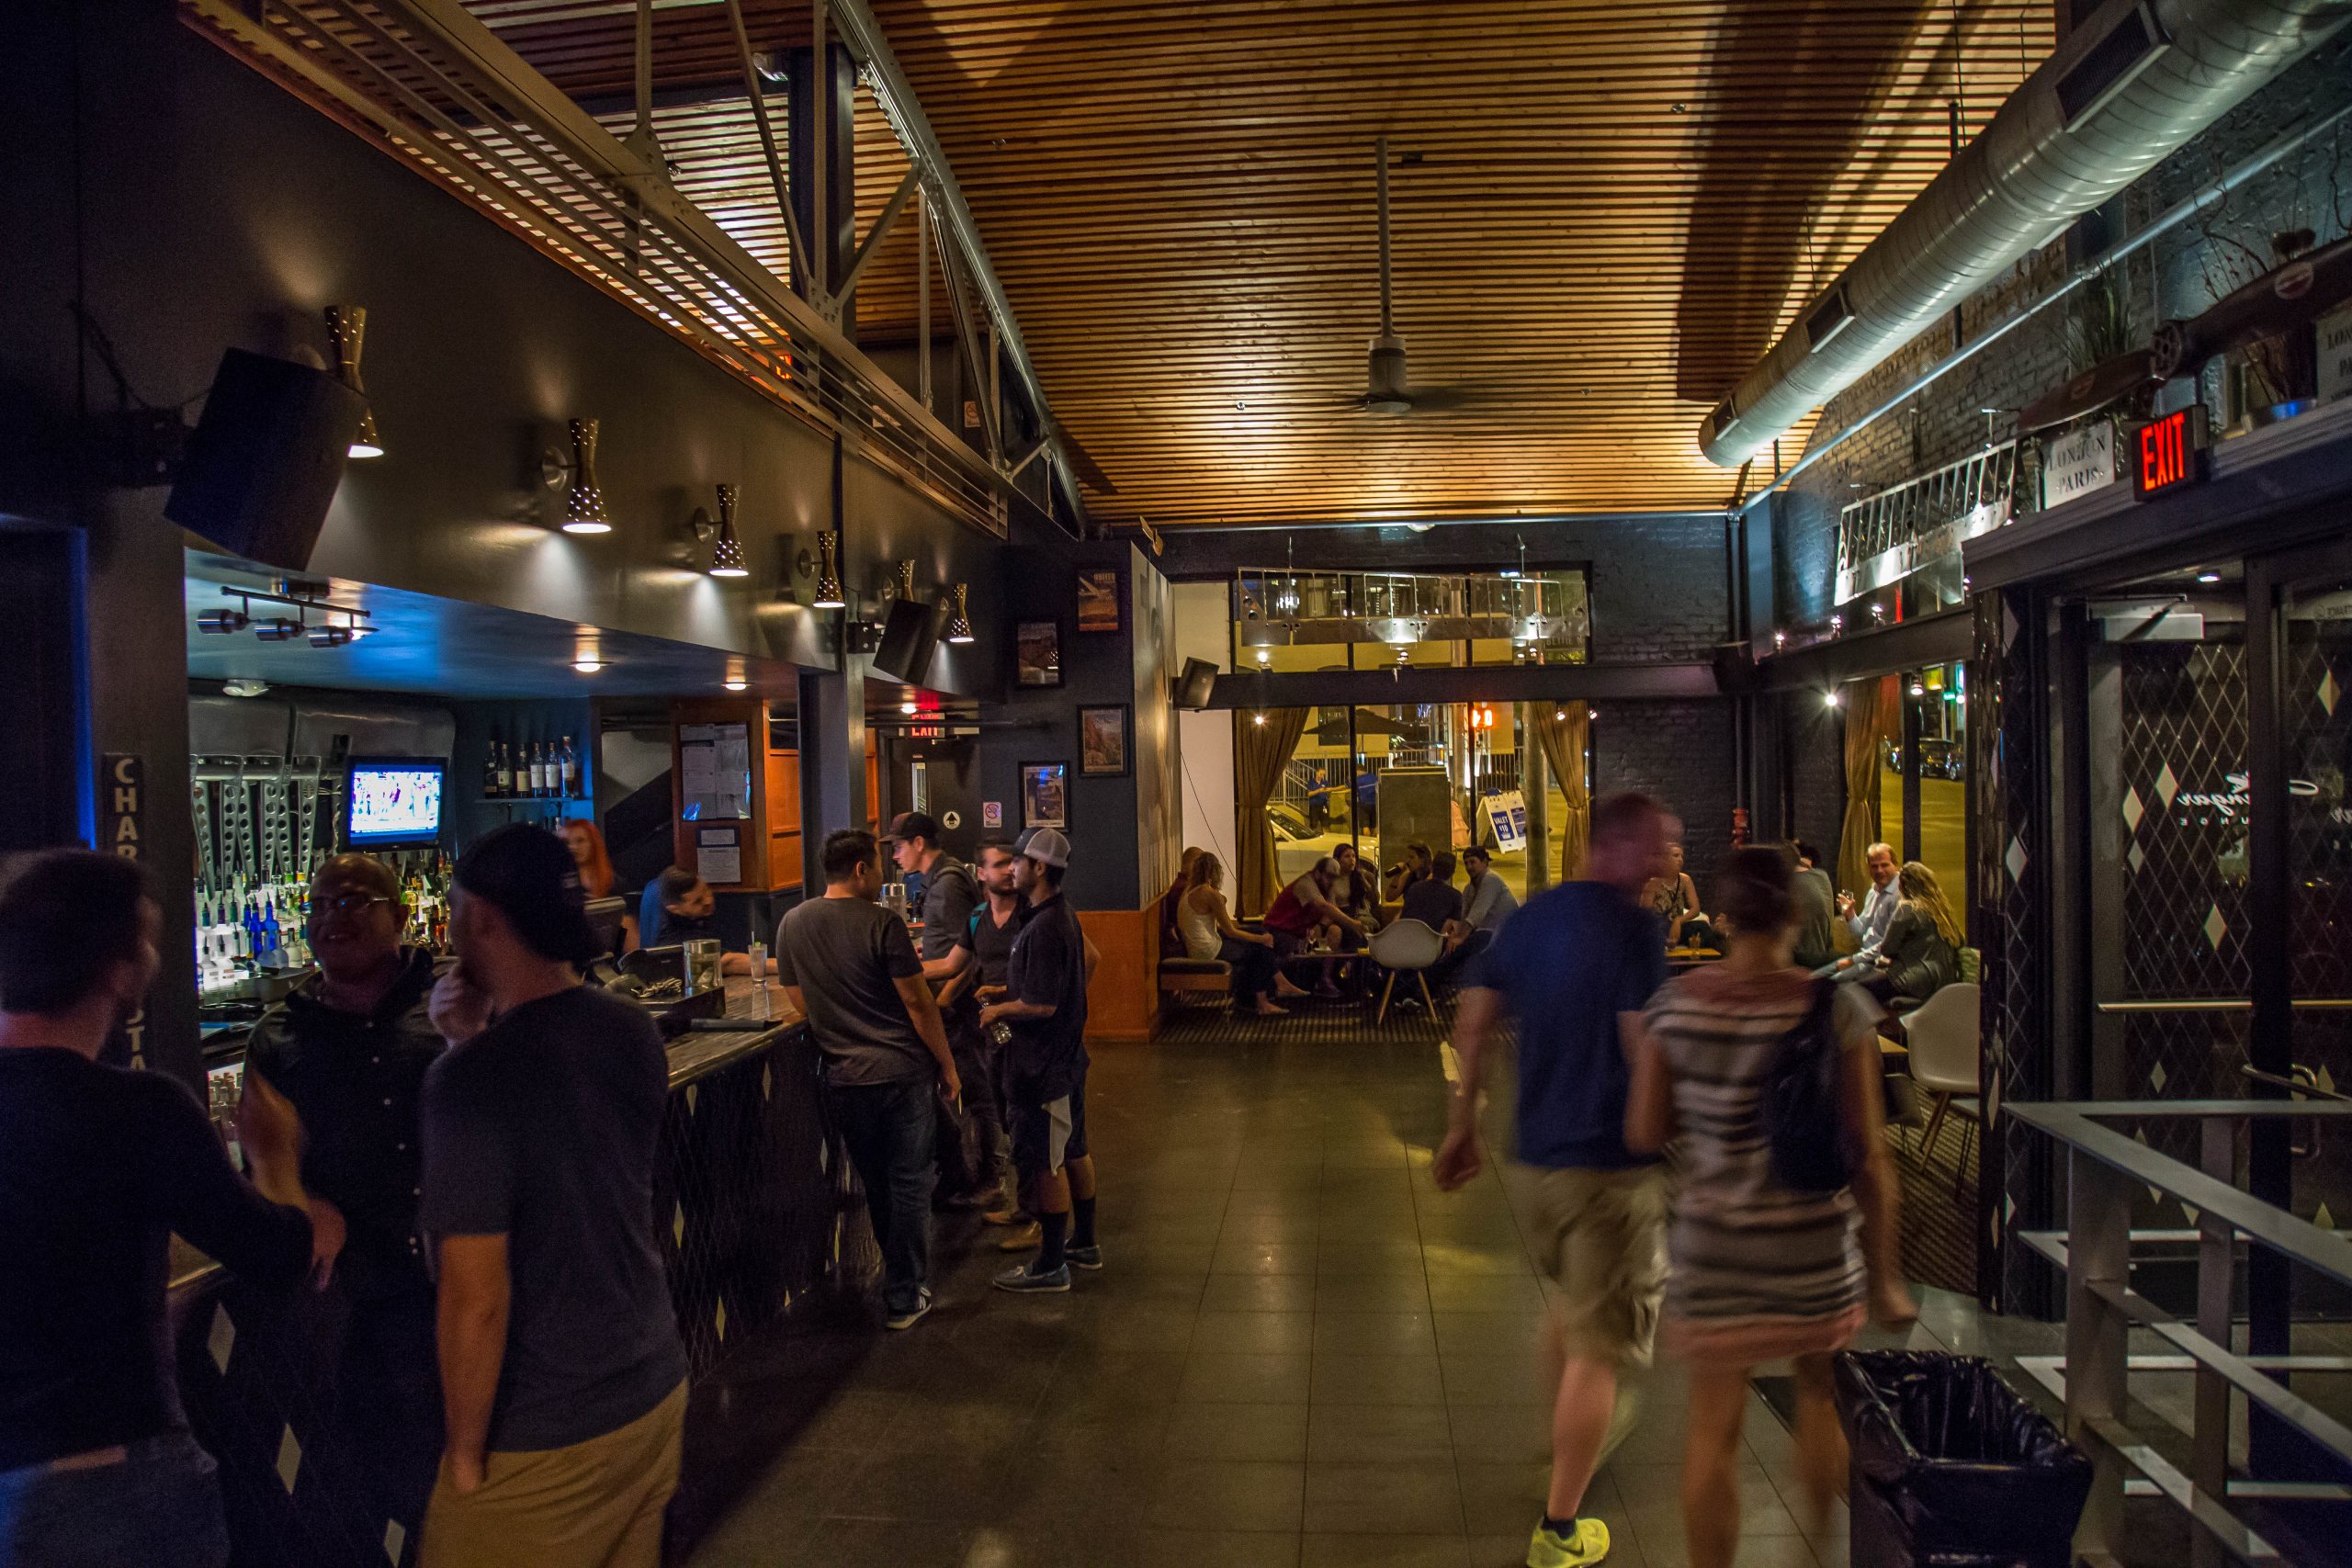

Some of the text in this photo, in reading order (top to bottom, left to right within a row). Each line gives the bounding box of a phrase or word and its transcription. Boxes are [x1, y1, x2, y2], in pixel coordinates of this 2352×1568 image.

[2141, 412, 2185, 491] EXIT
[2058, 466, 2100, 493] PARIS
[115, 758, 138, 863] CHAR
[1493, 816, 1509, 825] VALET
